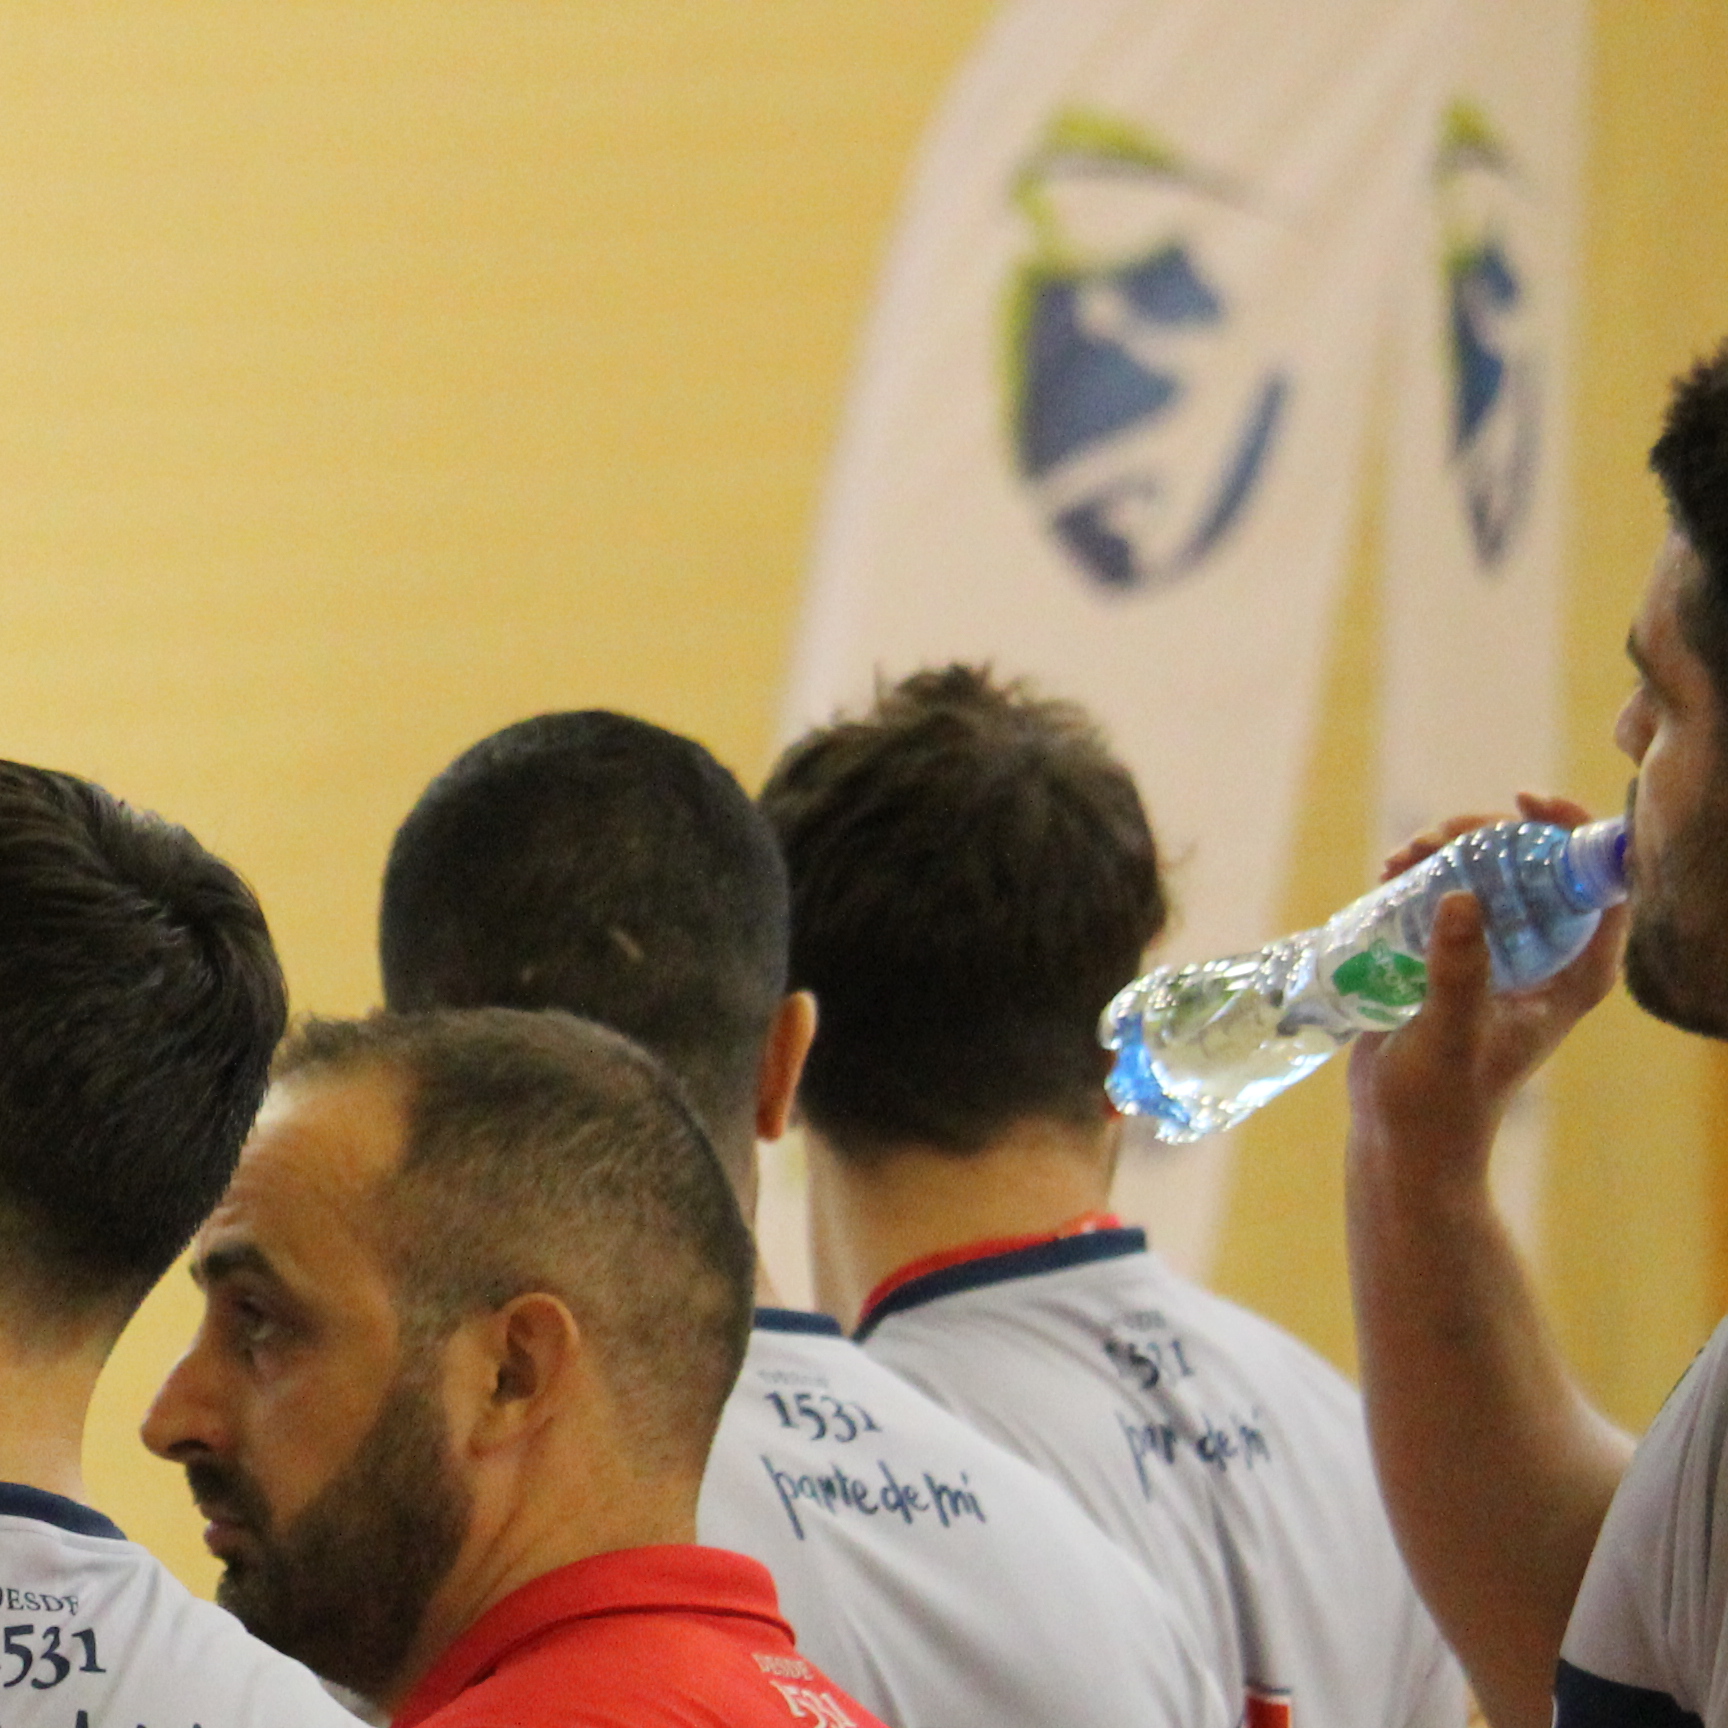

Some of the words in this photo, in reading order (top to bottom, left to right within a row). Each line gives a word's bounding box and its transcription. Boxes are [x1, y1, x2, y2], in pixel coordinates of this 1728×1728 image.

[764, 1391, 884, 1443] 1531
[878, 1459, 929, 1525] de
[922, 1469, 986, 1528] mi
